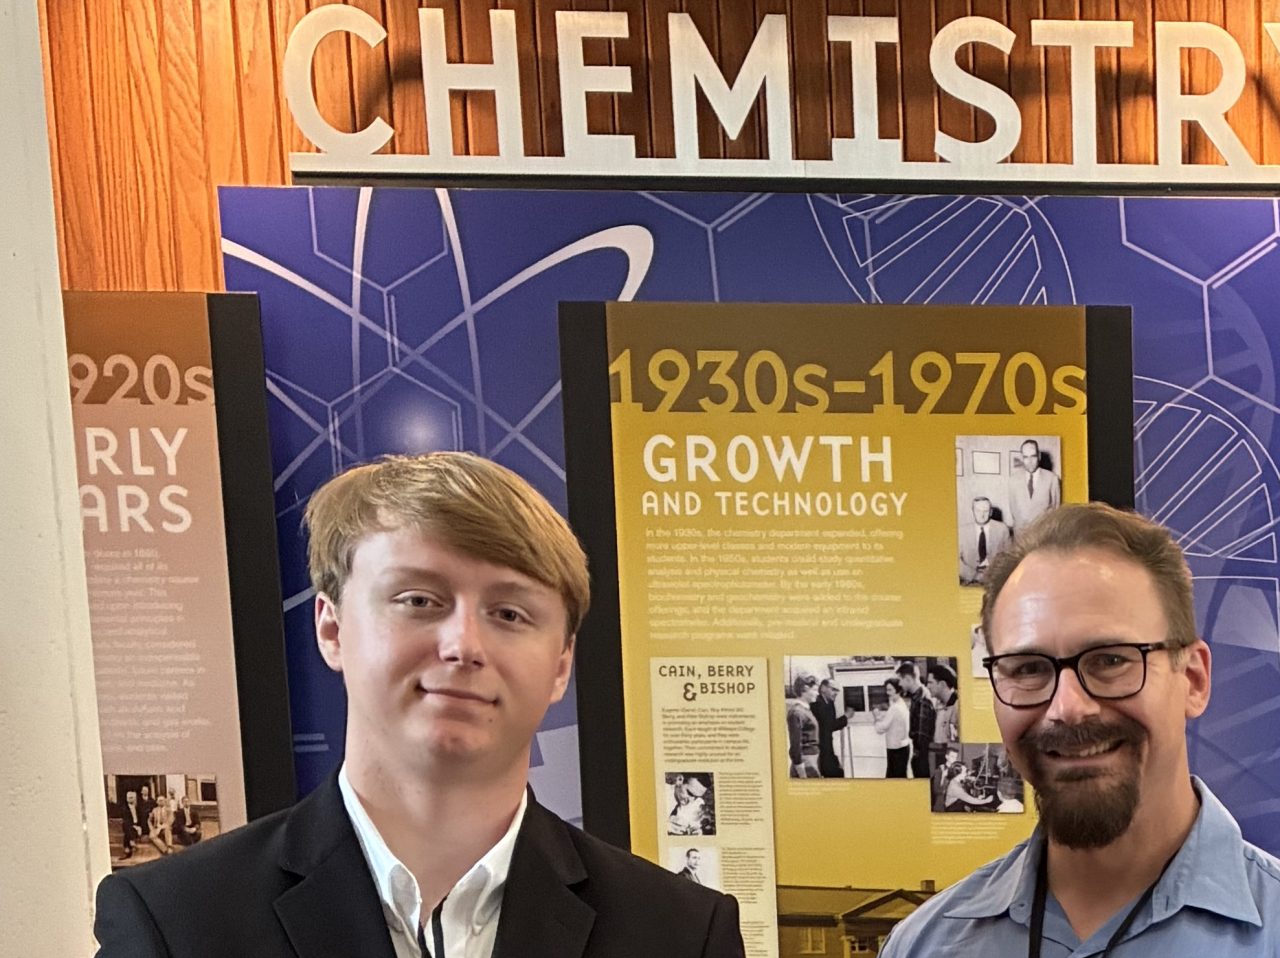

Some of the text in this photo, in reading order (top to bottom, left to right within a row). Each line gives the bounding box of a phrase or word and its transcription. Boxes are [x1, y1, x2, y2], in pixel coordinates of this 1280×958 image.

[68, 353, 215, 406] 920s
[85, 427, 188, 476] RLY
[643, 433, 893, 484] GROWTH
[79, 485, 192, 533] ARS
[642, 491, 908, 517] AND TECHNOLOGY
[658, 665, 754, 680] CAIN, BERRY
[683, 682, 756, 701] & BISHOP
